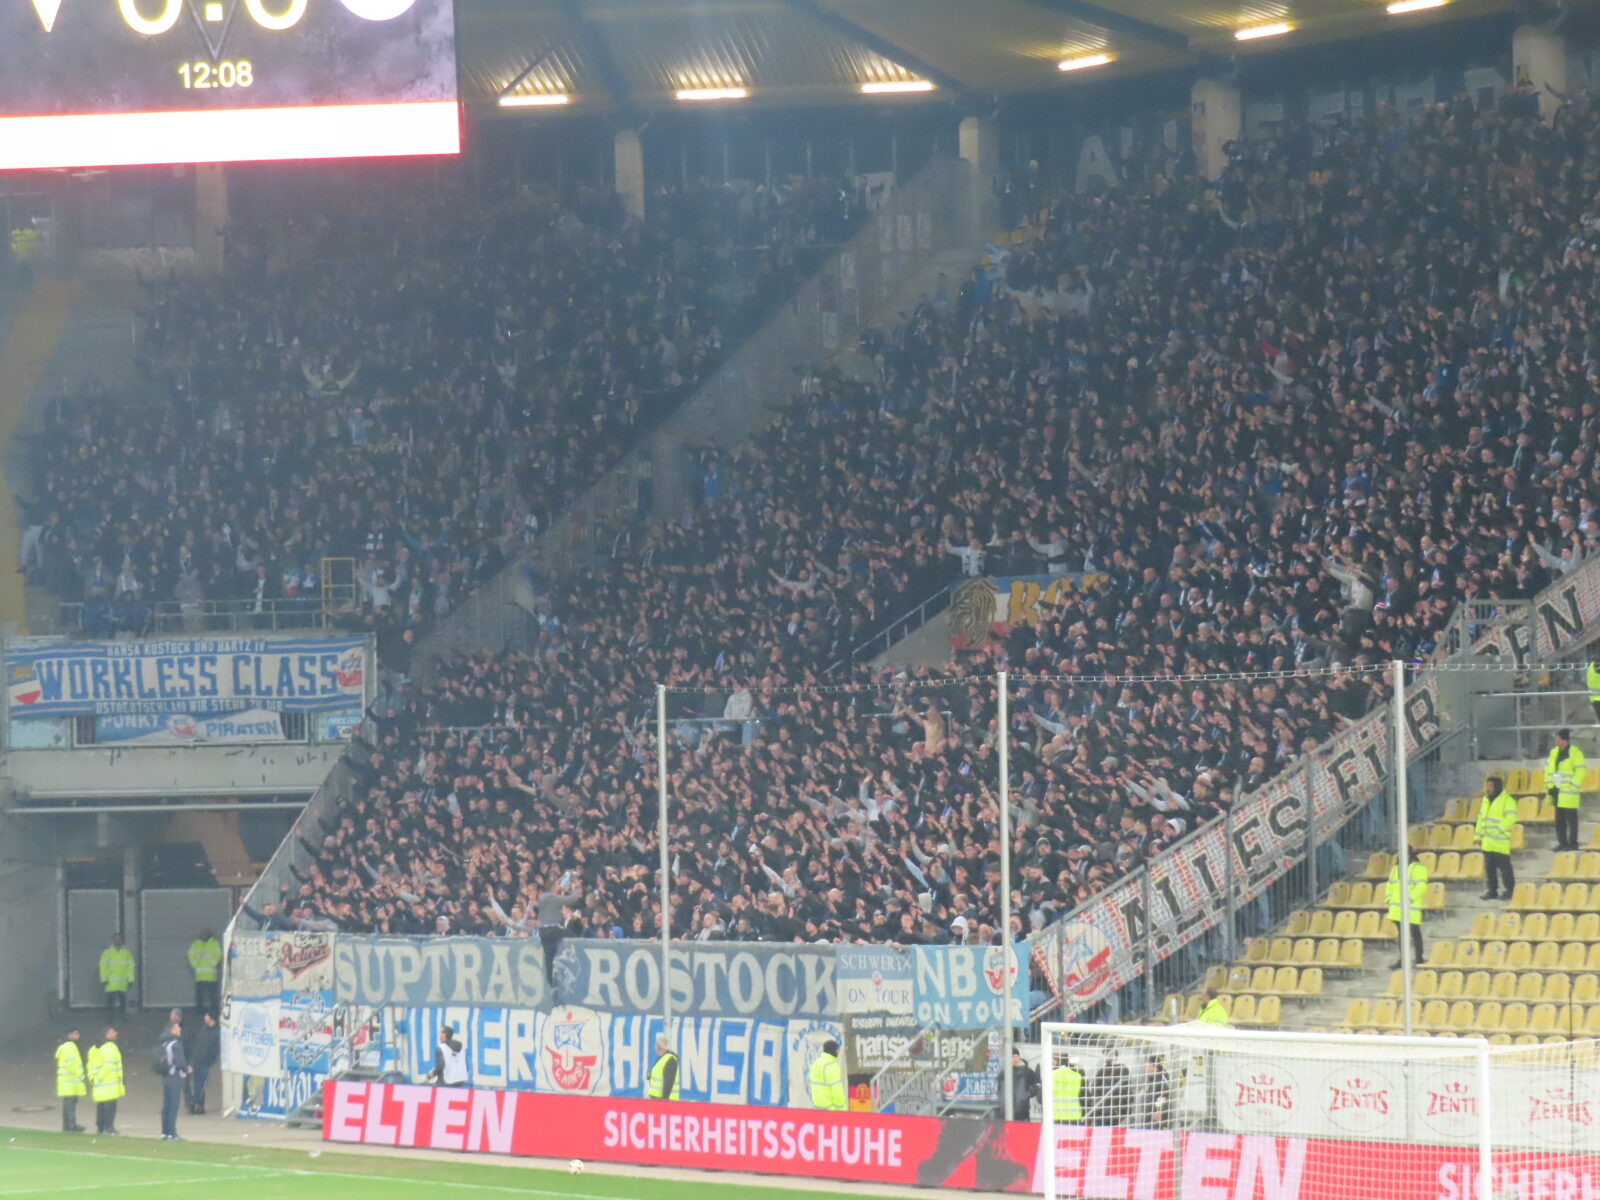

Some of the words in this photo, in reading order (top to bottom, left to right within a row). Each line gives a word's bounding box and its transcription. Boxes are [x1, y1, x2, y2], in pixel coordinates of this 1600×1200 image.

[178, 61, 254, 89] 12:08
[144, 641, 191, 655] ROSTOCK
[34, 655, 219, 701] WORKLESS
[231, 654, 339, 697] CLASS
[205, 719, 279, 738] PIRATEN
[335, 942, 545, 1007] SUPTRAS
[581, 947, 837, 1017] ROSTOCK
[916, 946, 978, 999] NB
[848, 987, 866, 1004] ON
[875, 987, 910, 1005] TOUR
[917, 1002, 951, 1025] ON
[957, 998, 1024, 1025] TOUR
[612, 1014, 787, 1105] HNSA
[1235, 1081, 1293, 1110] ZENTIS
[1328, 1086, 1389, 1115] ZENTIS
[1426, 1090, 1480, 1117] ZENTI
[329, 1081, 519, 1154] ELTEN
[603, 1109, 903, 1168] SICHERHEITSSCHUHE
[1528, 1095, 1593, 1126] ZENTIS
[1030, 1122, 1309, 1200] ELTEN
